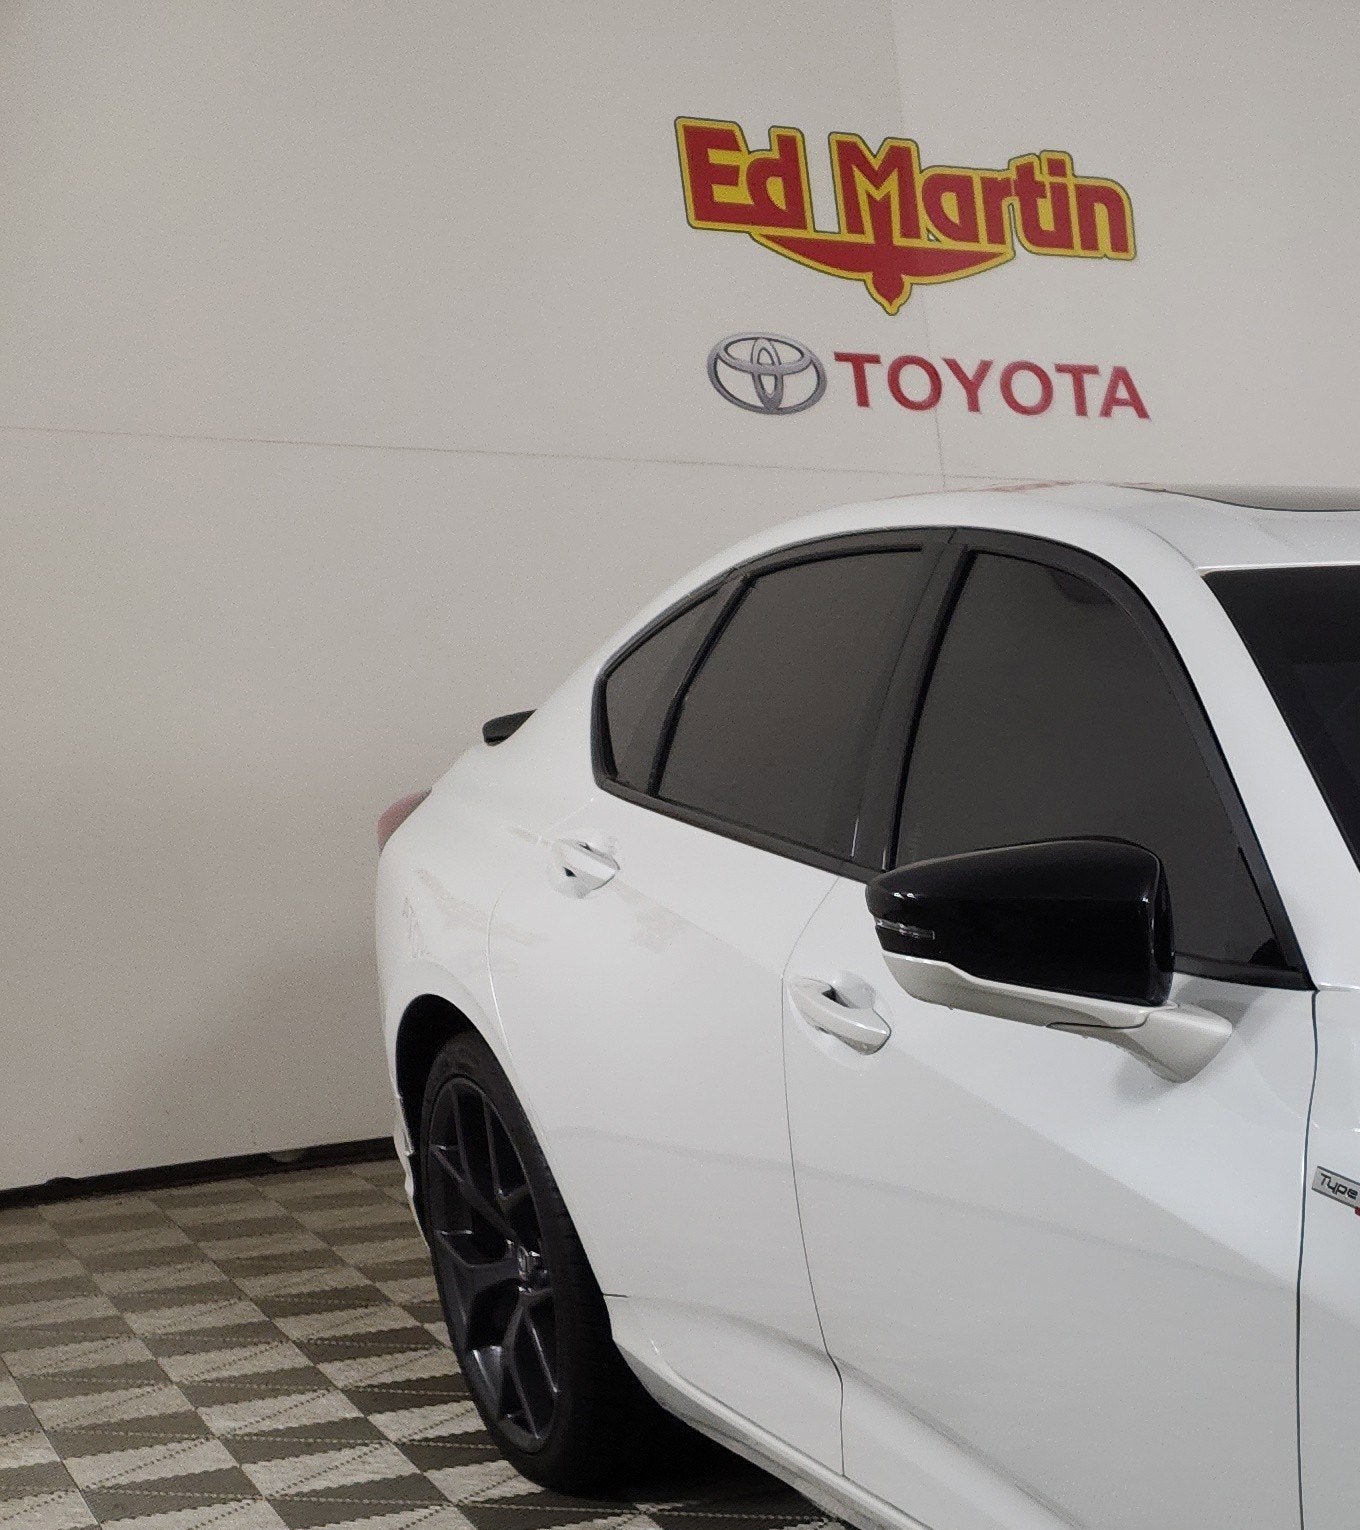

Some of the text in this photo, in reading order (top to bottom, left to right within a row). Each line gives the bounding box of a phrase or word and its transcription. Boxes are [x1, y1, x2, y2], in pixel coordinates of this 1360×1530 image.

[677, 120, 1133, 257] Ed Martin
[834, 351, 1151, 420] TOYOTA
[1319, 1173, 1359, 1200] Type
